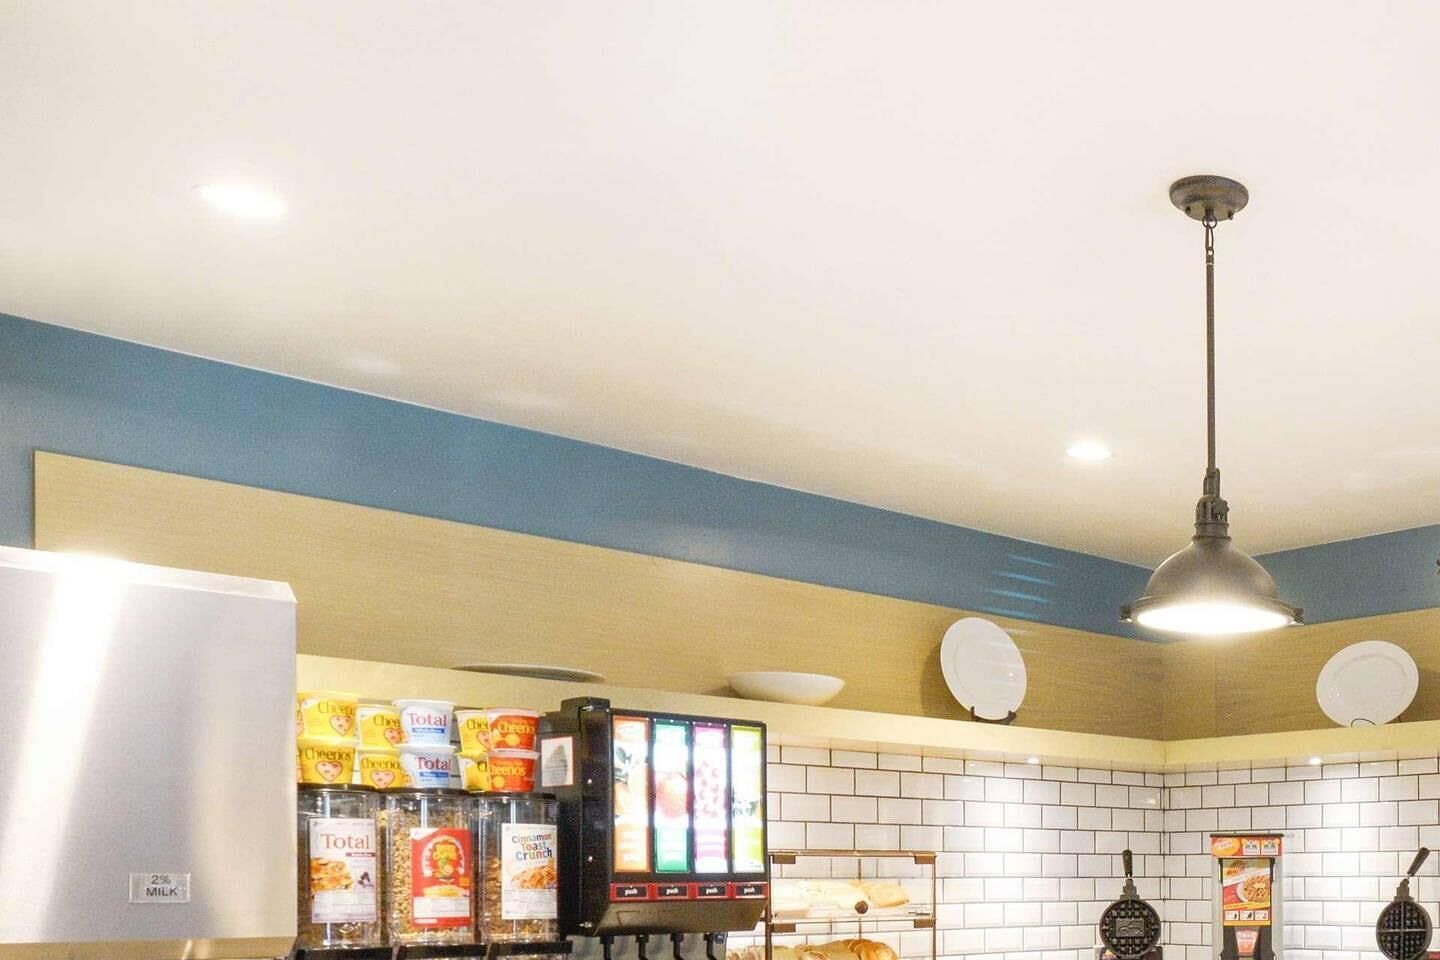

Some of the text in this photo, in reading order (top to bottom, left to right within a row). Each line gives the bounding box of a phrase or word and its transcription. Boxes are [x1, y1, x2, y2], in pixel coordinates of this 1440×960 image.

[408, 713, 447, 727] Total
[305, 747, 352, 761] Cheerios
[416, 757, 453, 770] Total
[320, 833, 369, 849] Total
[511, 833, 552, 844] Cinnamon
[521, 841, 547, 851] Toast
[515, 847, 553, 861] Crunch
[151, 874, 171, 885] 2%
[146, 887, 178, 897] MILK
[666, 887, 679, 895] push
[706, 886, 718, 894] push
